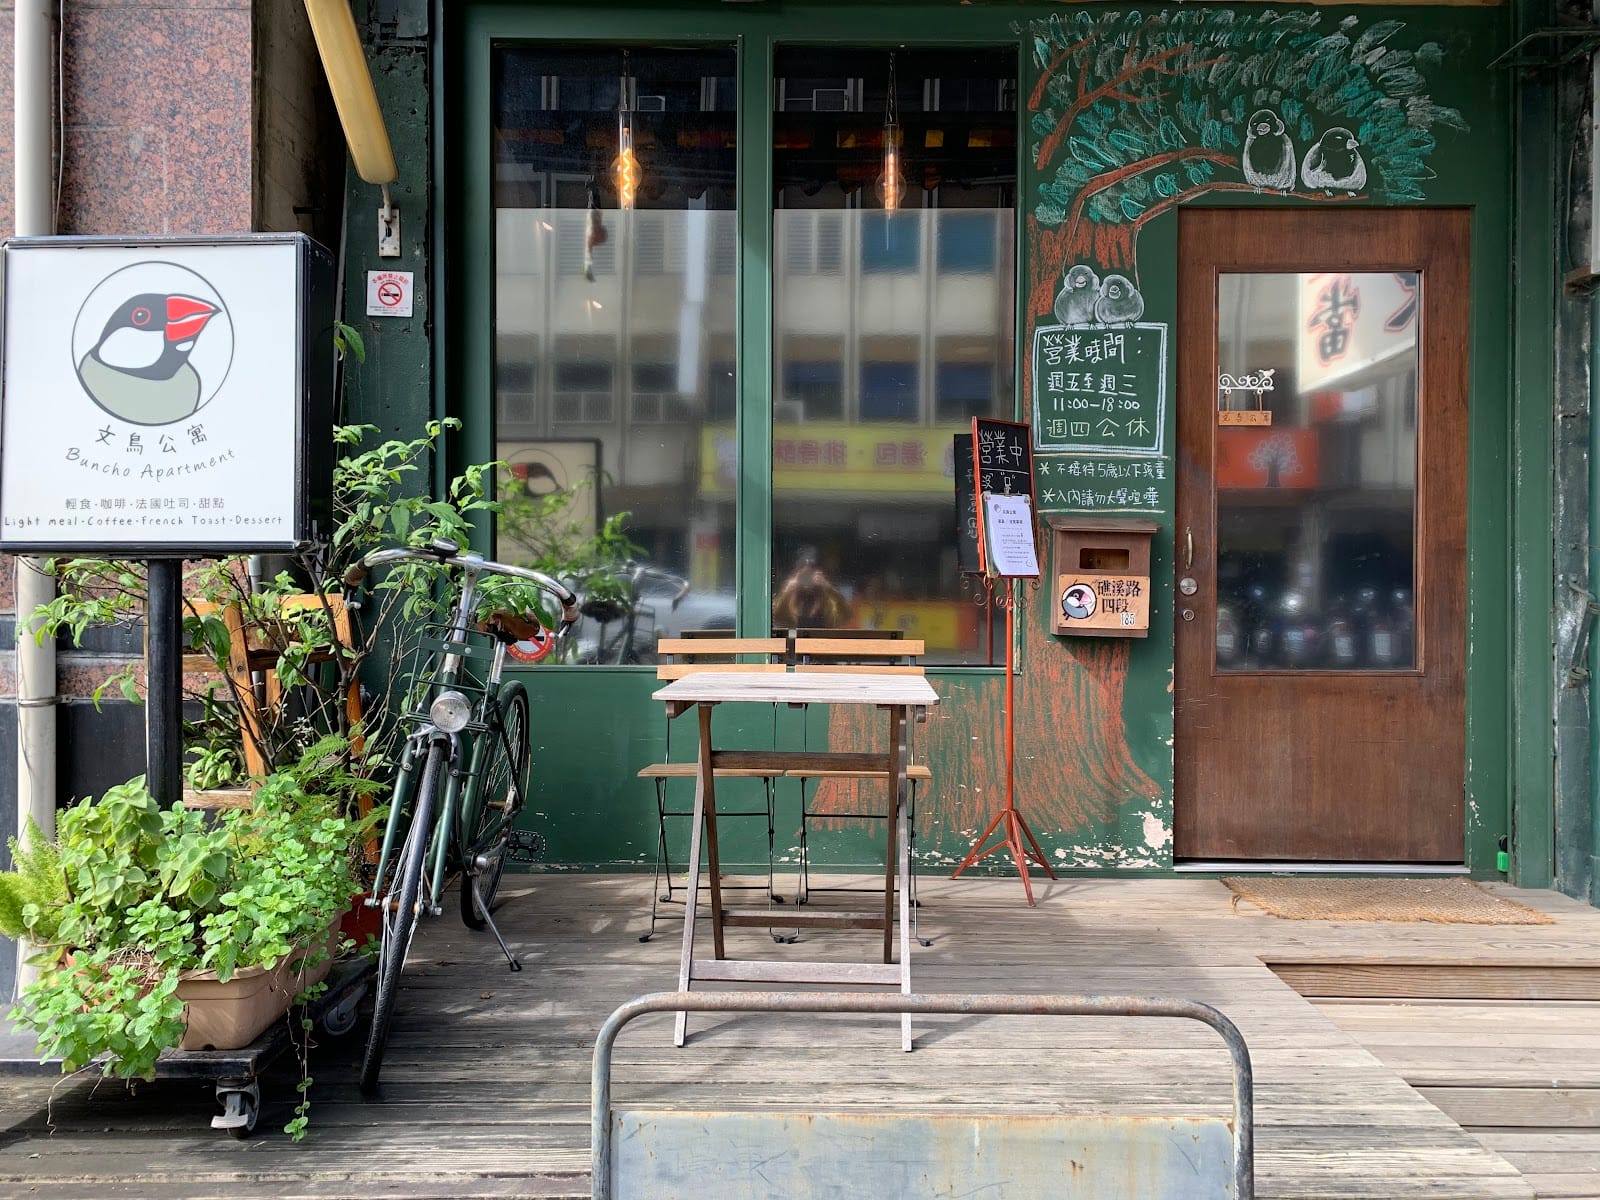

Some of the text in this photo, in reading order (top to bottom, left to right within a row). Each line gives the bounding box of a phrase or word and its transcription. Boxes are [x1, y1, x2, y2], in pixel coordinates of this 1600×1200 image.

[1047, 371, 1138, 397] 週五至週三
[95, 423, 208, 455] 文鳥公寓
[1046, 417, 1150, 438] 週四公休
[978, 429, 1023, 467] 營業中
[65, 447, 236, 483] Buncho Apartment
[4, 516, 40, 528] Light
[1097, 579, 1142, 597] 礁溪路
[1102, 598, 1129, 614] 四段
